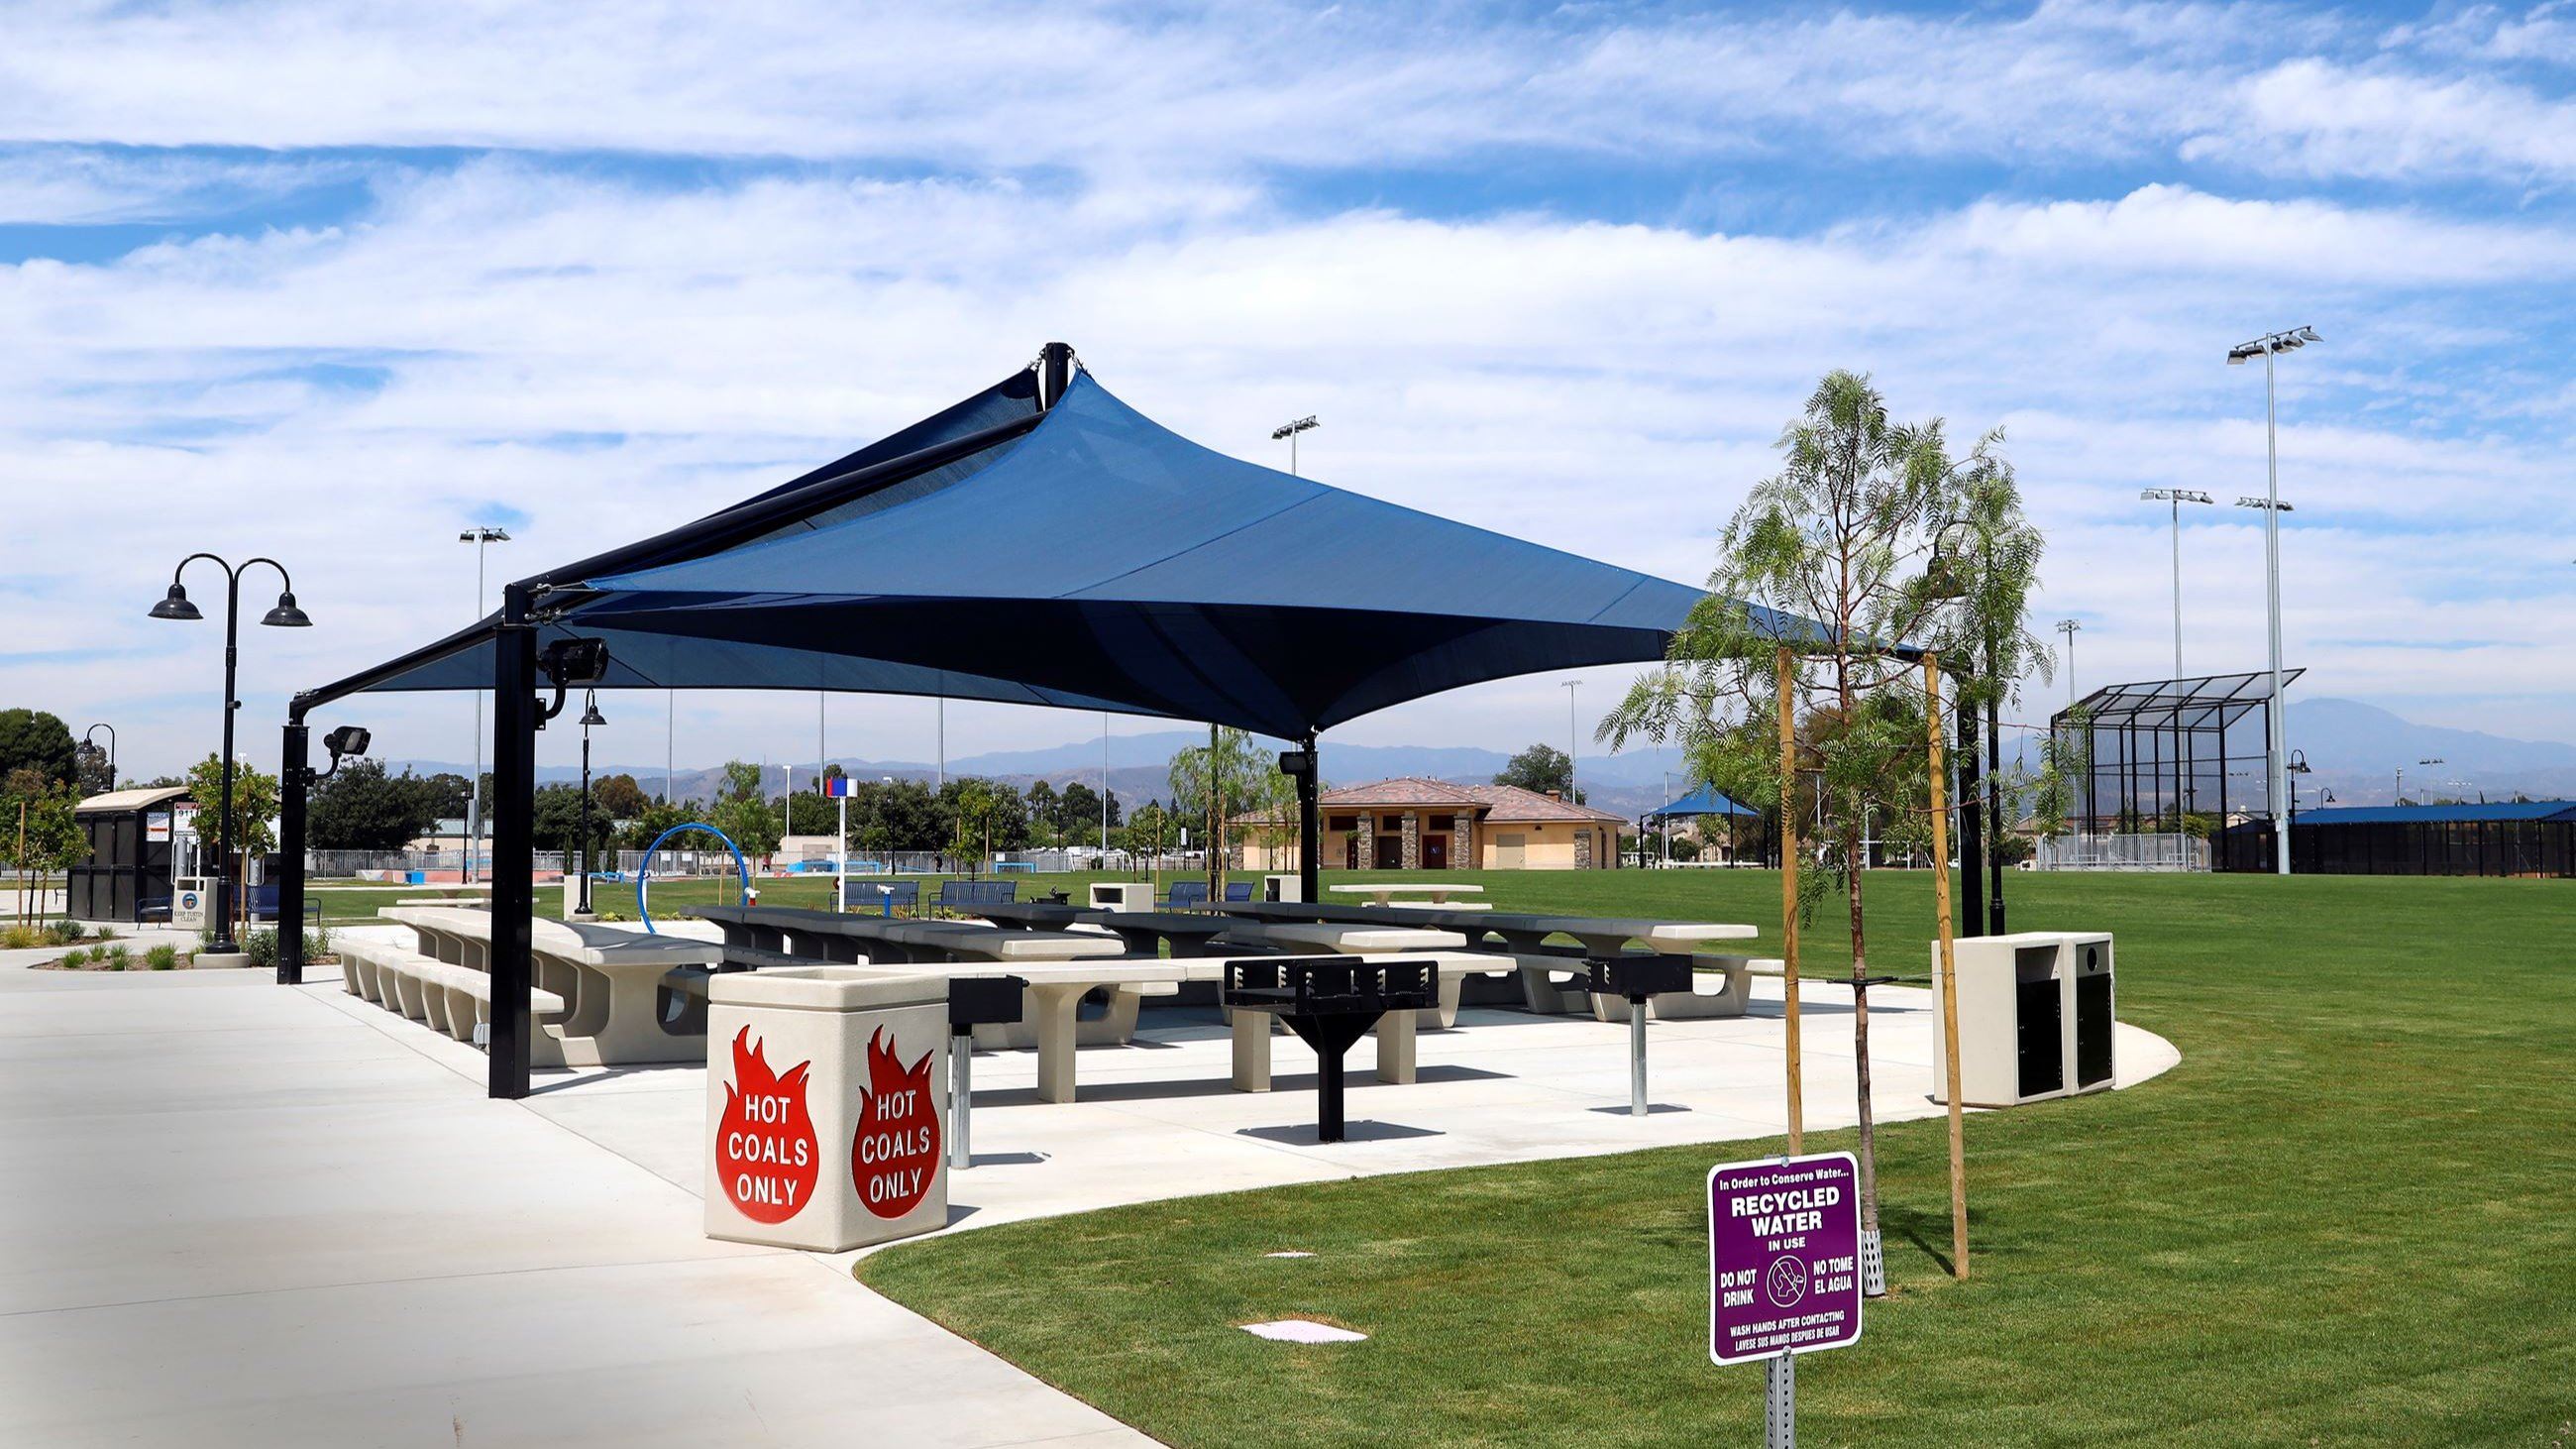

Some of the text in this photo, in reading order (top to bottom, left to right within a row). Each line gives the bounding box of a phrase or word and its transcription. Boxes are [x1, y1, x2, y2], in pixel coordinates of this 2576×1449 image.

[745, 1094, 792, 1124] HOT
[877, 1089, 916, 1122] HOT
[728, 1132, 808, 1167] COALS
[861, 1126, 930, 1165] COALS
[736, 1173, 799, 1206] ONLY
[870, 1168, 922, 1203] ONLY
[1719, 1168, 1849, 1190] In Order to Conserve Water...
[1731, 1186, 1840, 1217] RECYCLED
[1751, 1211, 1823, 1237] WATER
[1768, 1237, 1806, 1252] IN USE
[1720, 1269, 1758, 1288] DO NOT
[1813, 1256, 1854, 1276] NO TOME
[1723, 1288, 1755, 1307] DRINK
[1814, 1275, 1853, 1294] EL AGUA
[1730, 1309, 1845, 1337] WASH HANDS AFTER CONTACTING
[1735, 1325, 1840, 1352] LAVESE SUS MANOS DESPUES DE USAR
